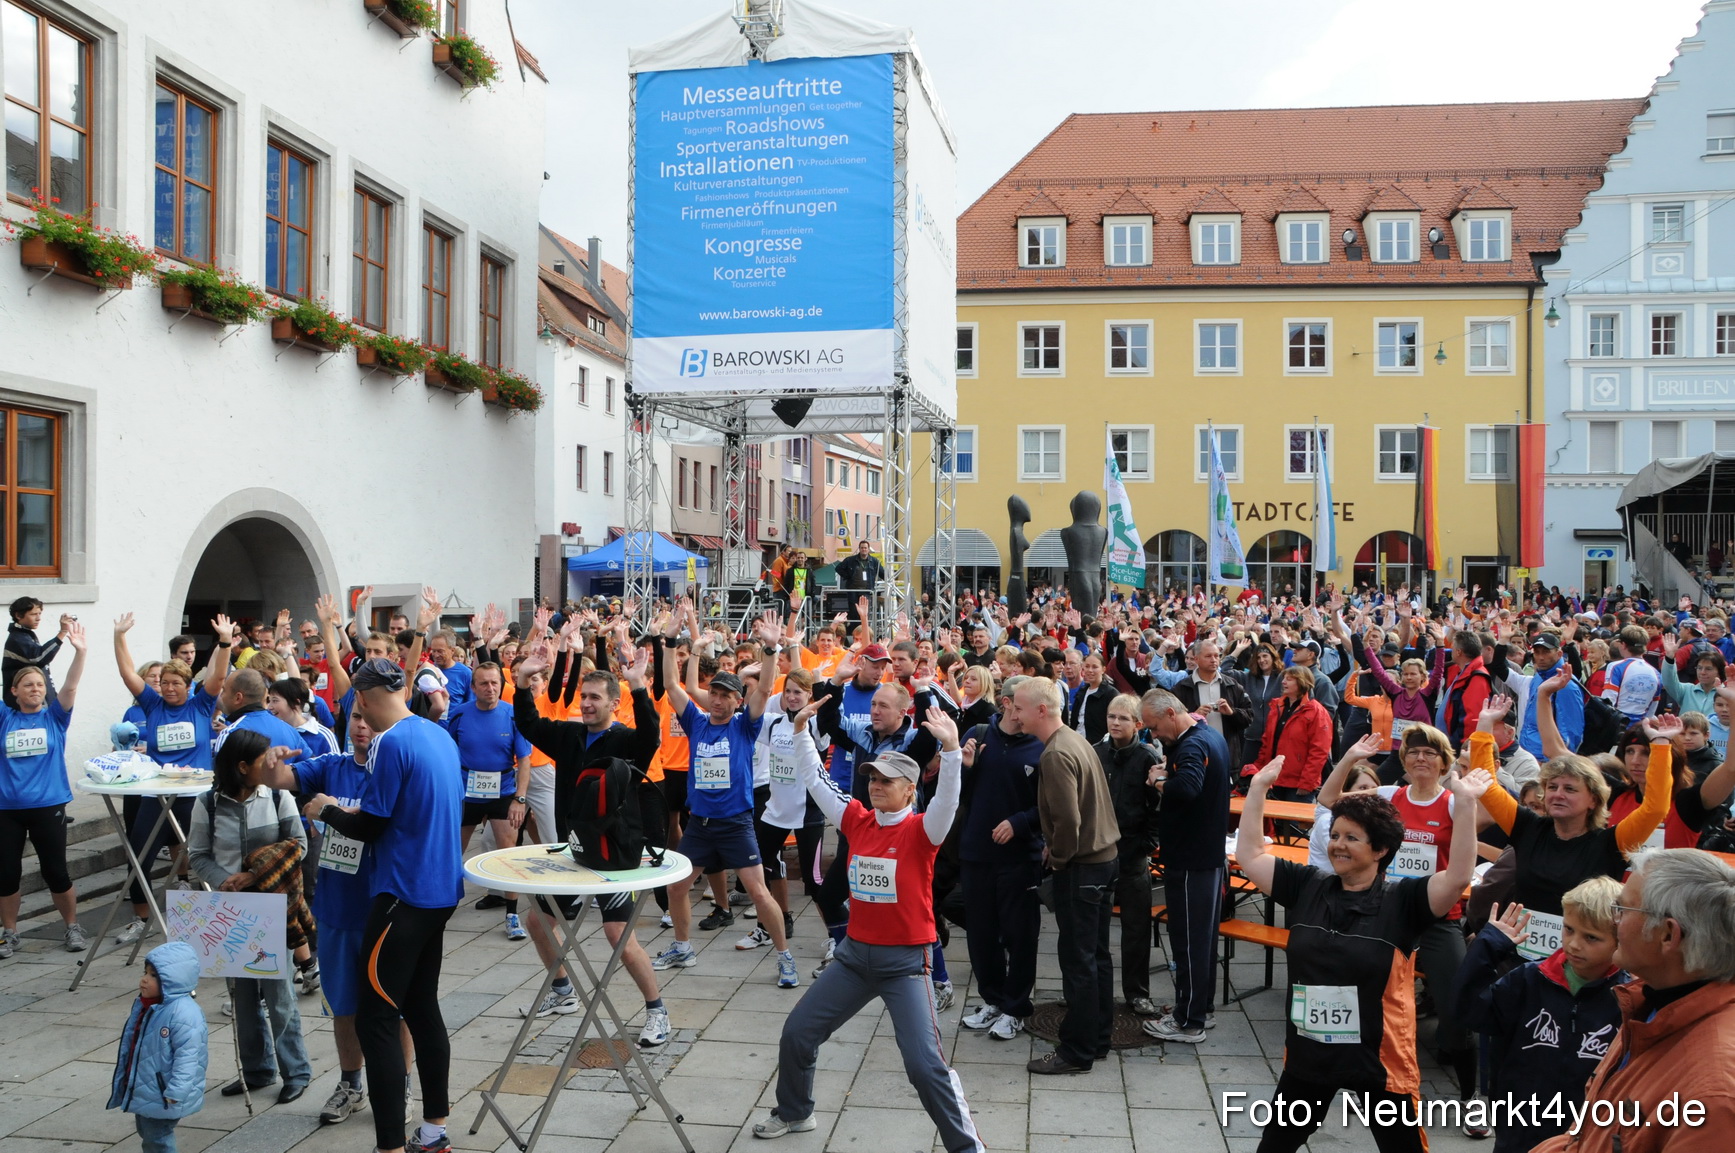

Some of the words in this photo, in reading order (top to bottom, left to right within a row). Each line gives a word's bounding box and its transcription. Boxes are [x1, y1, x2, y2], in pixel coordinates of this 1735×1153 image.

[683, 77, 842, 106] Messeauftritte
[661, 101, 806, 123] Hauptversammlungen
[809, 102, 824, 112] Get
[826, 100, 863, 112] together
[683, 124, 723, 136] Tagungen
[725, 116, 825, 136] Roadshows
[676, 133, 849, 158] Sportveranstaltungen
[660, 155, 794, 178] Installationen
[797, 156, 867, 167] TV-Produktionen
[674, 174, 803, 192] Kulturveranstaltungen
[695, 191, 750, 203] Fashionshows
[754, 186, 849, 199] Produktpräsentationen
[681, 199, 838, 221] Firmeneröffnungen
[701, 219, 764, 231] Firmenjubiläum
[761, 226, 814, 236] Firmenfeiern
[704, 236, 803, 257] Kongresse
[755, 254, 797, 265] Musicals
[713, 264, 787, 281] Konzerte
[731, 279, 777, 289] Tourservice
[699, 305, 823, 321] www.barowski-ag.de
[712, 349, 810, 368] BAROWSKI
[816, 348, 844, 365] AG
[713, 367, 769, 377] Veranstaltungs-
[771, 366, 784, 375] und
[786, 365, 843, 377] Mediensysteme
[1657, 379, 1729, 396] BRILLEN
[17, 737, 43, 748] 5170
[167, 732, 192, 742] 5163
[704, 769, 726, 779] 2542
[775, 765, 794, 775] 5107
[476, 781, 497, 790] 2974
[329, 843, 357, 860] 5083
[858, 860, 885, 871] Marliese
[1398, 857, 1430, 871] 3050
[860, 873, 889, 888] 2359
[199, 901, 242, 957] ANDRE
[222, 908, 258, 963] ANDRE
[1529, 931, 1563, 950] 516
[1309, 998, 1348, 1010] CHRISTA
[1309, 1008, 1352, 1025] 5157
